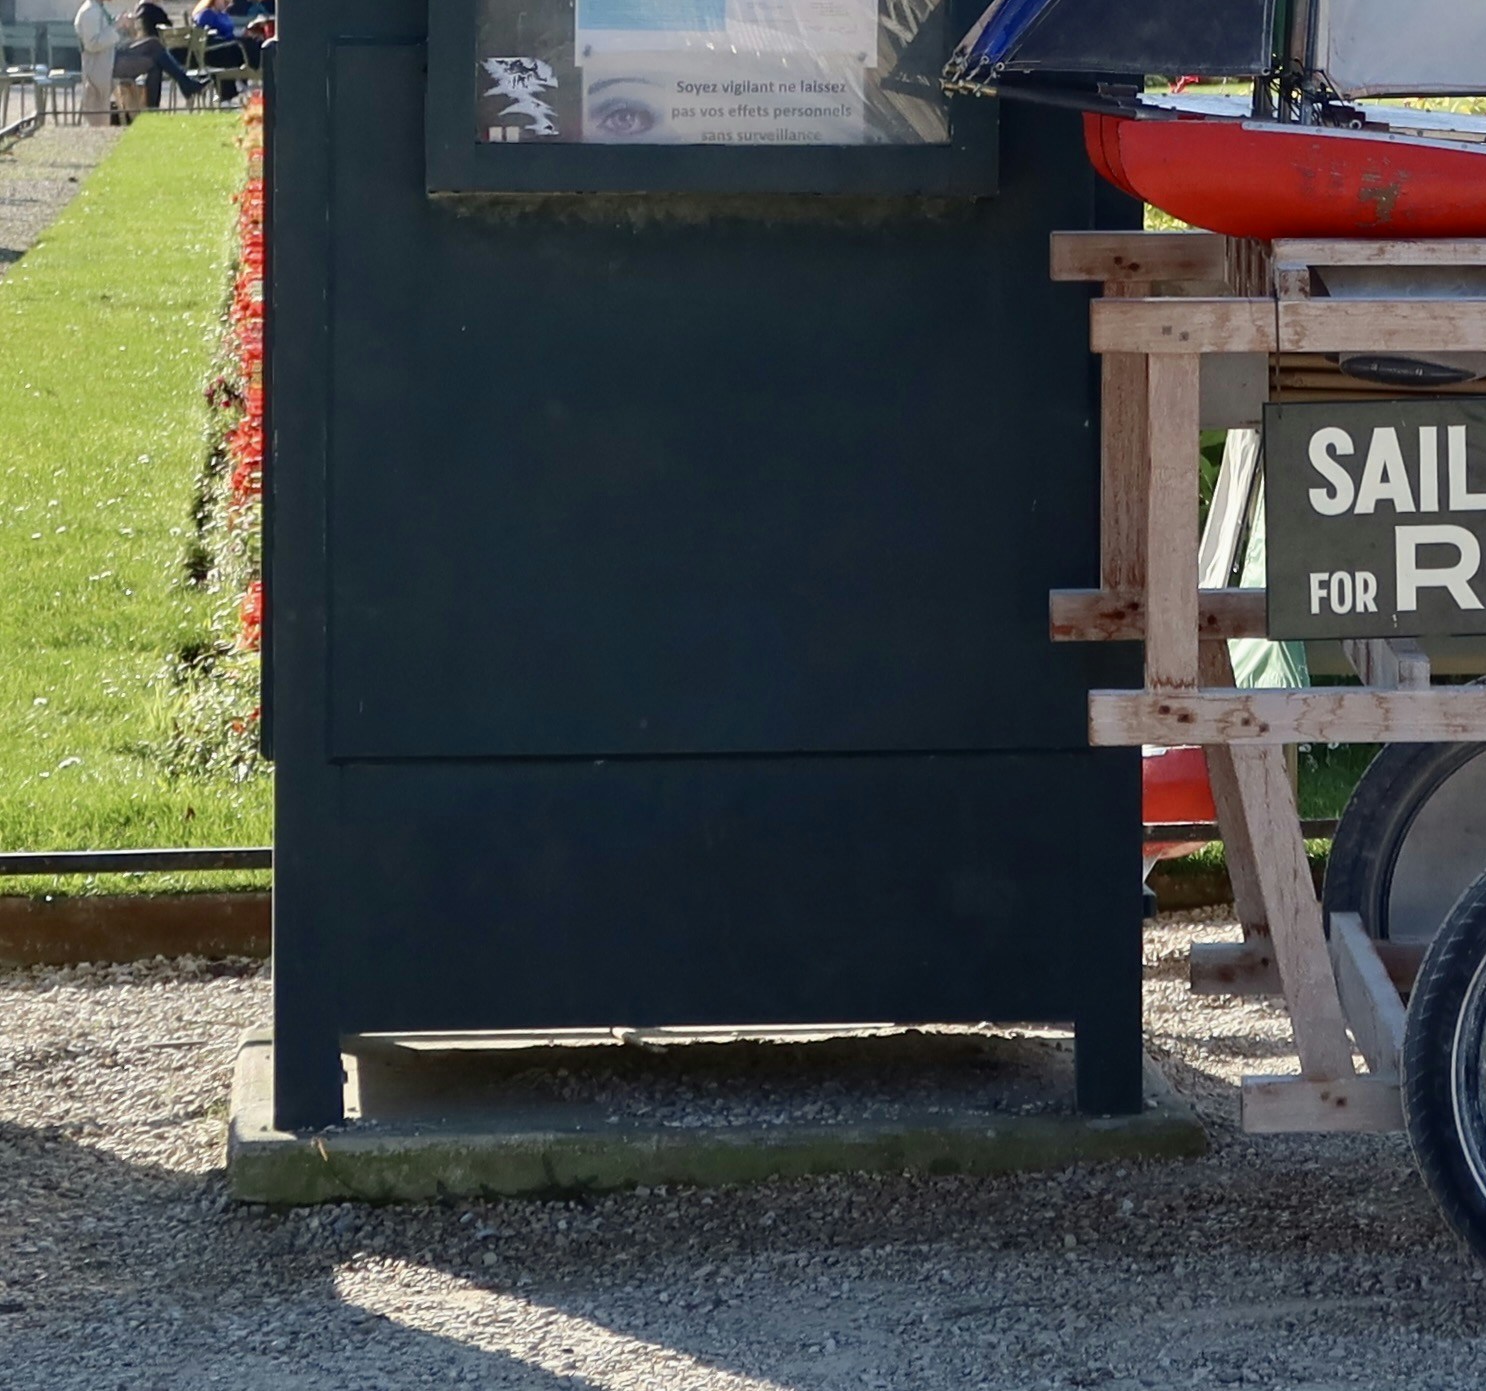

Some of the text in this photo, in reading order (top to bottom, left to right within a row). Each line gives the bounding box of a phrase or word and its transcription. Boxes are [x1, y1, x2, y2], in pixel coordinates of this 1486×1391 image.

[676, 80, 846, 97] Soyez vigilant ne laissez
[671, 104, 852, 120] pas vos effets personnels
[702, 128, 822, 142] sans surveillance
[1309, 570, 1378, 615] FOR
